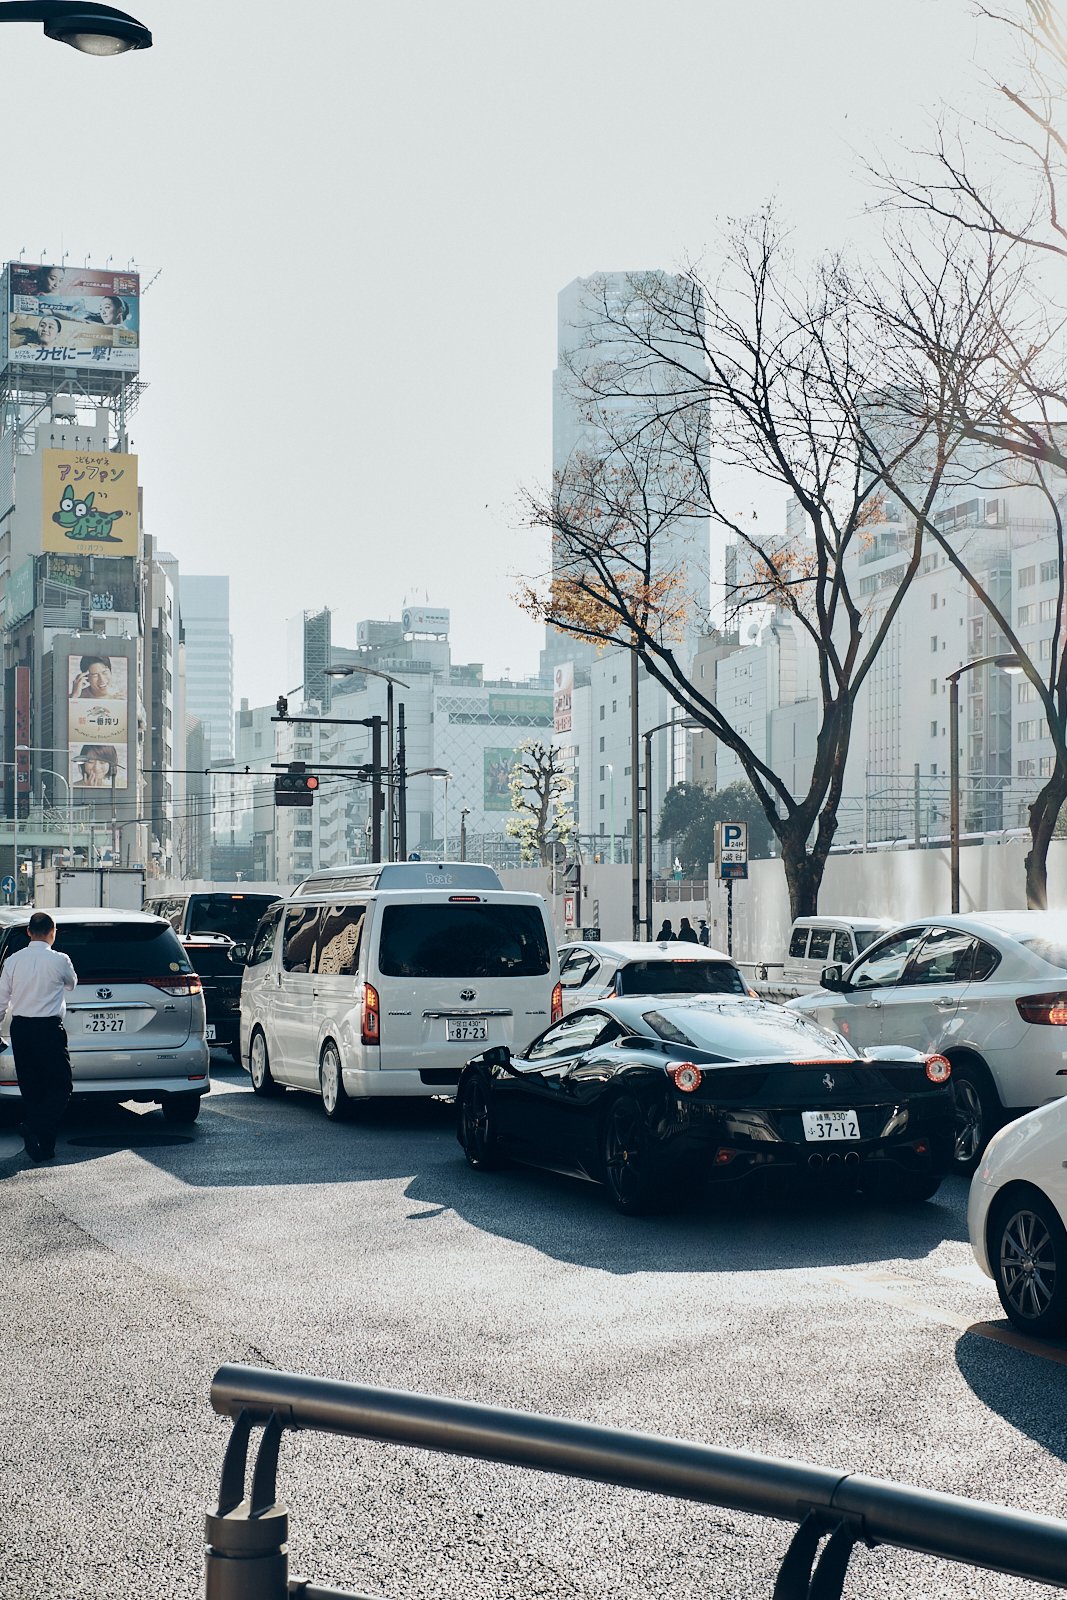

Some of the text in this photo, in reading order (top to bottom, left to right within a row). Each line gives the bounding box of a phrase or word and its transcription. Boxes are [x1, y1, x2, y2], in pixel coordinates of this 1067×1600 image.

[35, 345, 112, 361] カゼに一撃!
[57, 464, 125, 482] アンファン
[725, 826, 741, 847] P
[425, 872, 453, 885] Beat
[92, 1019, 124, 1032] 23-27
[456, 1027, 486, 1039] 87-23
[832, 1112, 845, 1121] 330
[816, 1122, 858, 1138] 37-12
